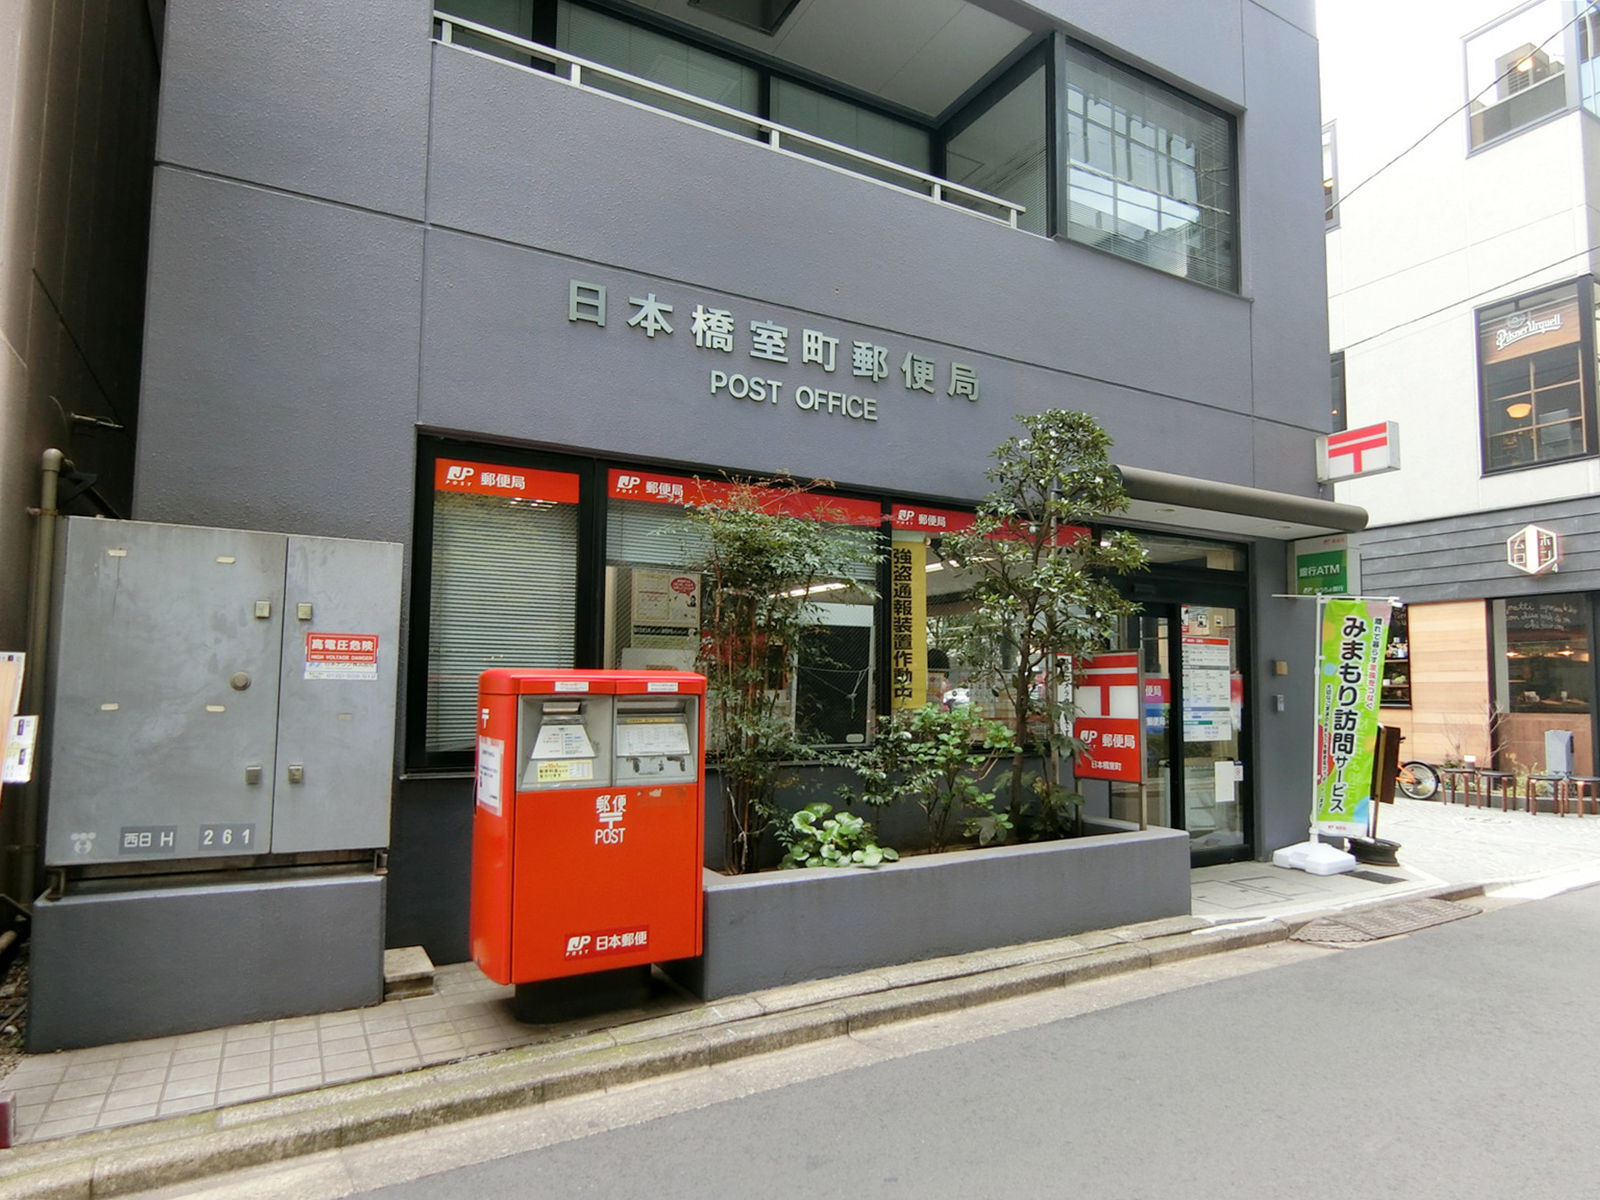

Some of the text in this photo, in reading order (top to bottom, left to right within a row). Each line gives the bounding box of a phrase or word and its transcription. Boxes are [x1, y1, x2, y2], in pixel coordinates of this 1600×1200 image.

[569, 279, 981, 401] 日本橋室町郵便局
[1496, 314, 1562, 350] Pilsner Urquell
[710, 369, 879, 422] POST OFFICE
[480, 472, 526, 490] 郵便局
[645, 481, 684, 497] 郵便局
[918, 514, 946, 528] 郵便局
[1551, 563, 1559, 573] 4
[893, 548, 913, 699] 強盗通報装置作動中
[312, 639, 373, 651] 高電圧危険
[1330, 616, 1367, 813] みまもり訪問サービス
[1102, 734, 1136, 749] 郵便局
[595, 794, 627, 813] 郵便
[160, 832, 174, 847] H
[594, 828, 626, 845] POST
[596, 931, 648, 951] 日本郵便
